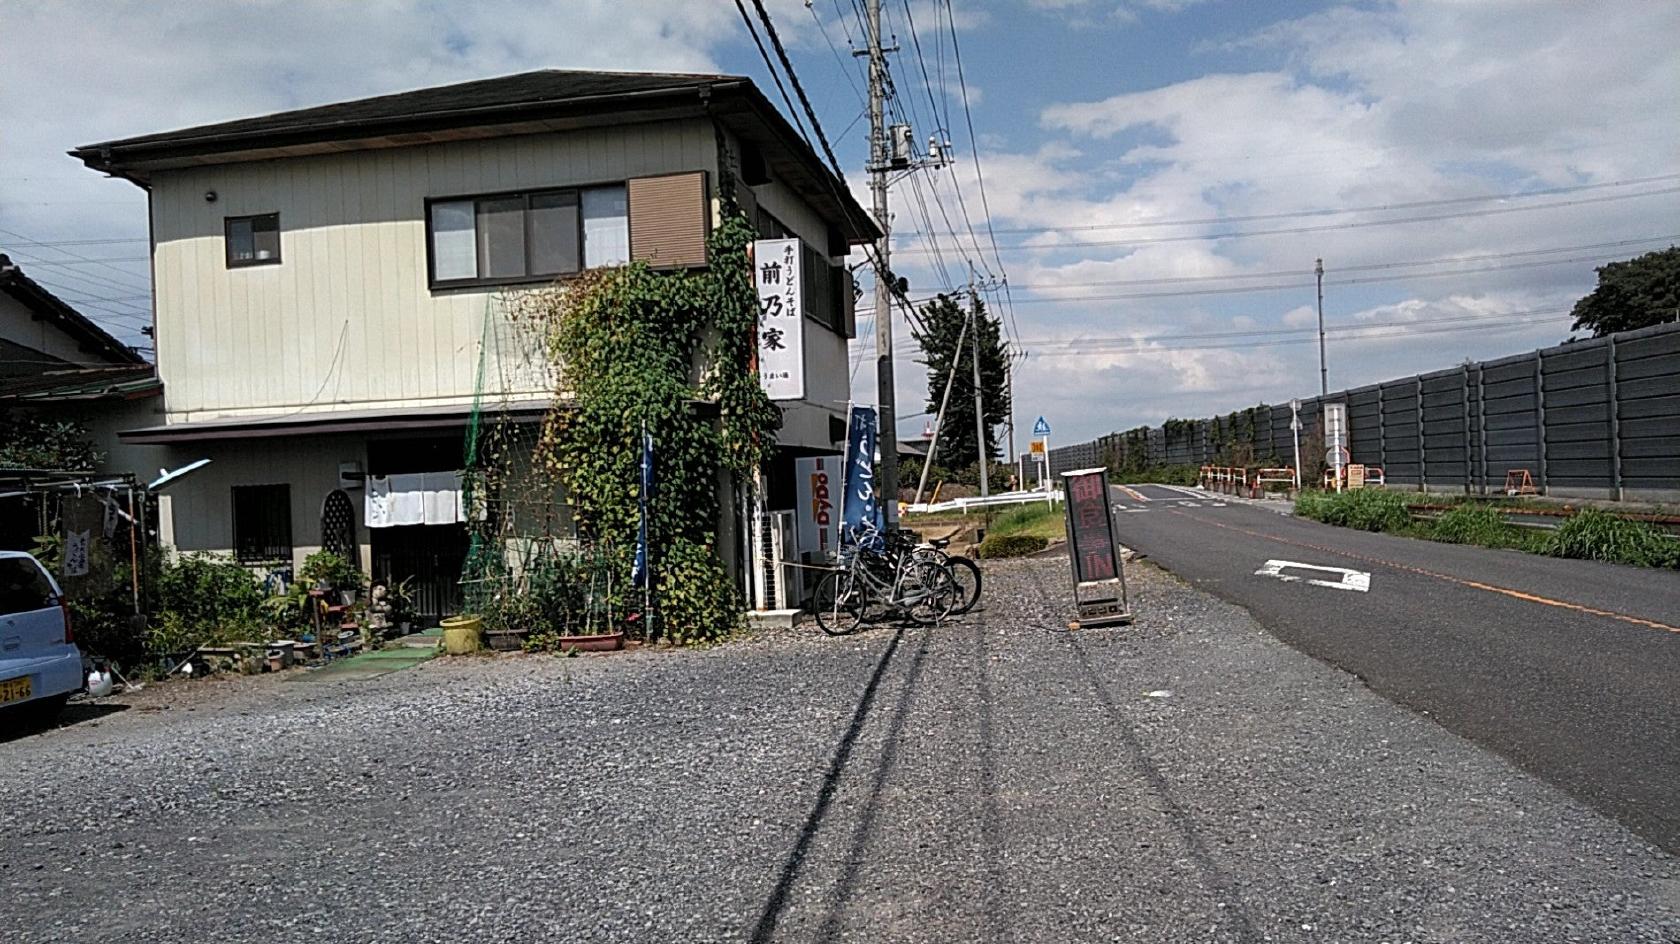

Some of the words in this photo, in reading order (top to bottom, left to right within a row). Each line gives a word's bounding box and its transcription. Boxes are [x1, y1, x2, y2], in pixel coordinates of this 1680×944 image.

[760, 261, 786, 351] 前乃家
[784, 245, 796, 316] 手打うどんそば
[816, 473, 832, 525] DyDo
